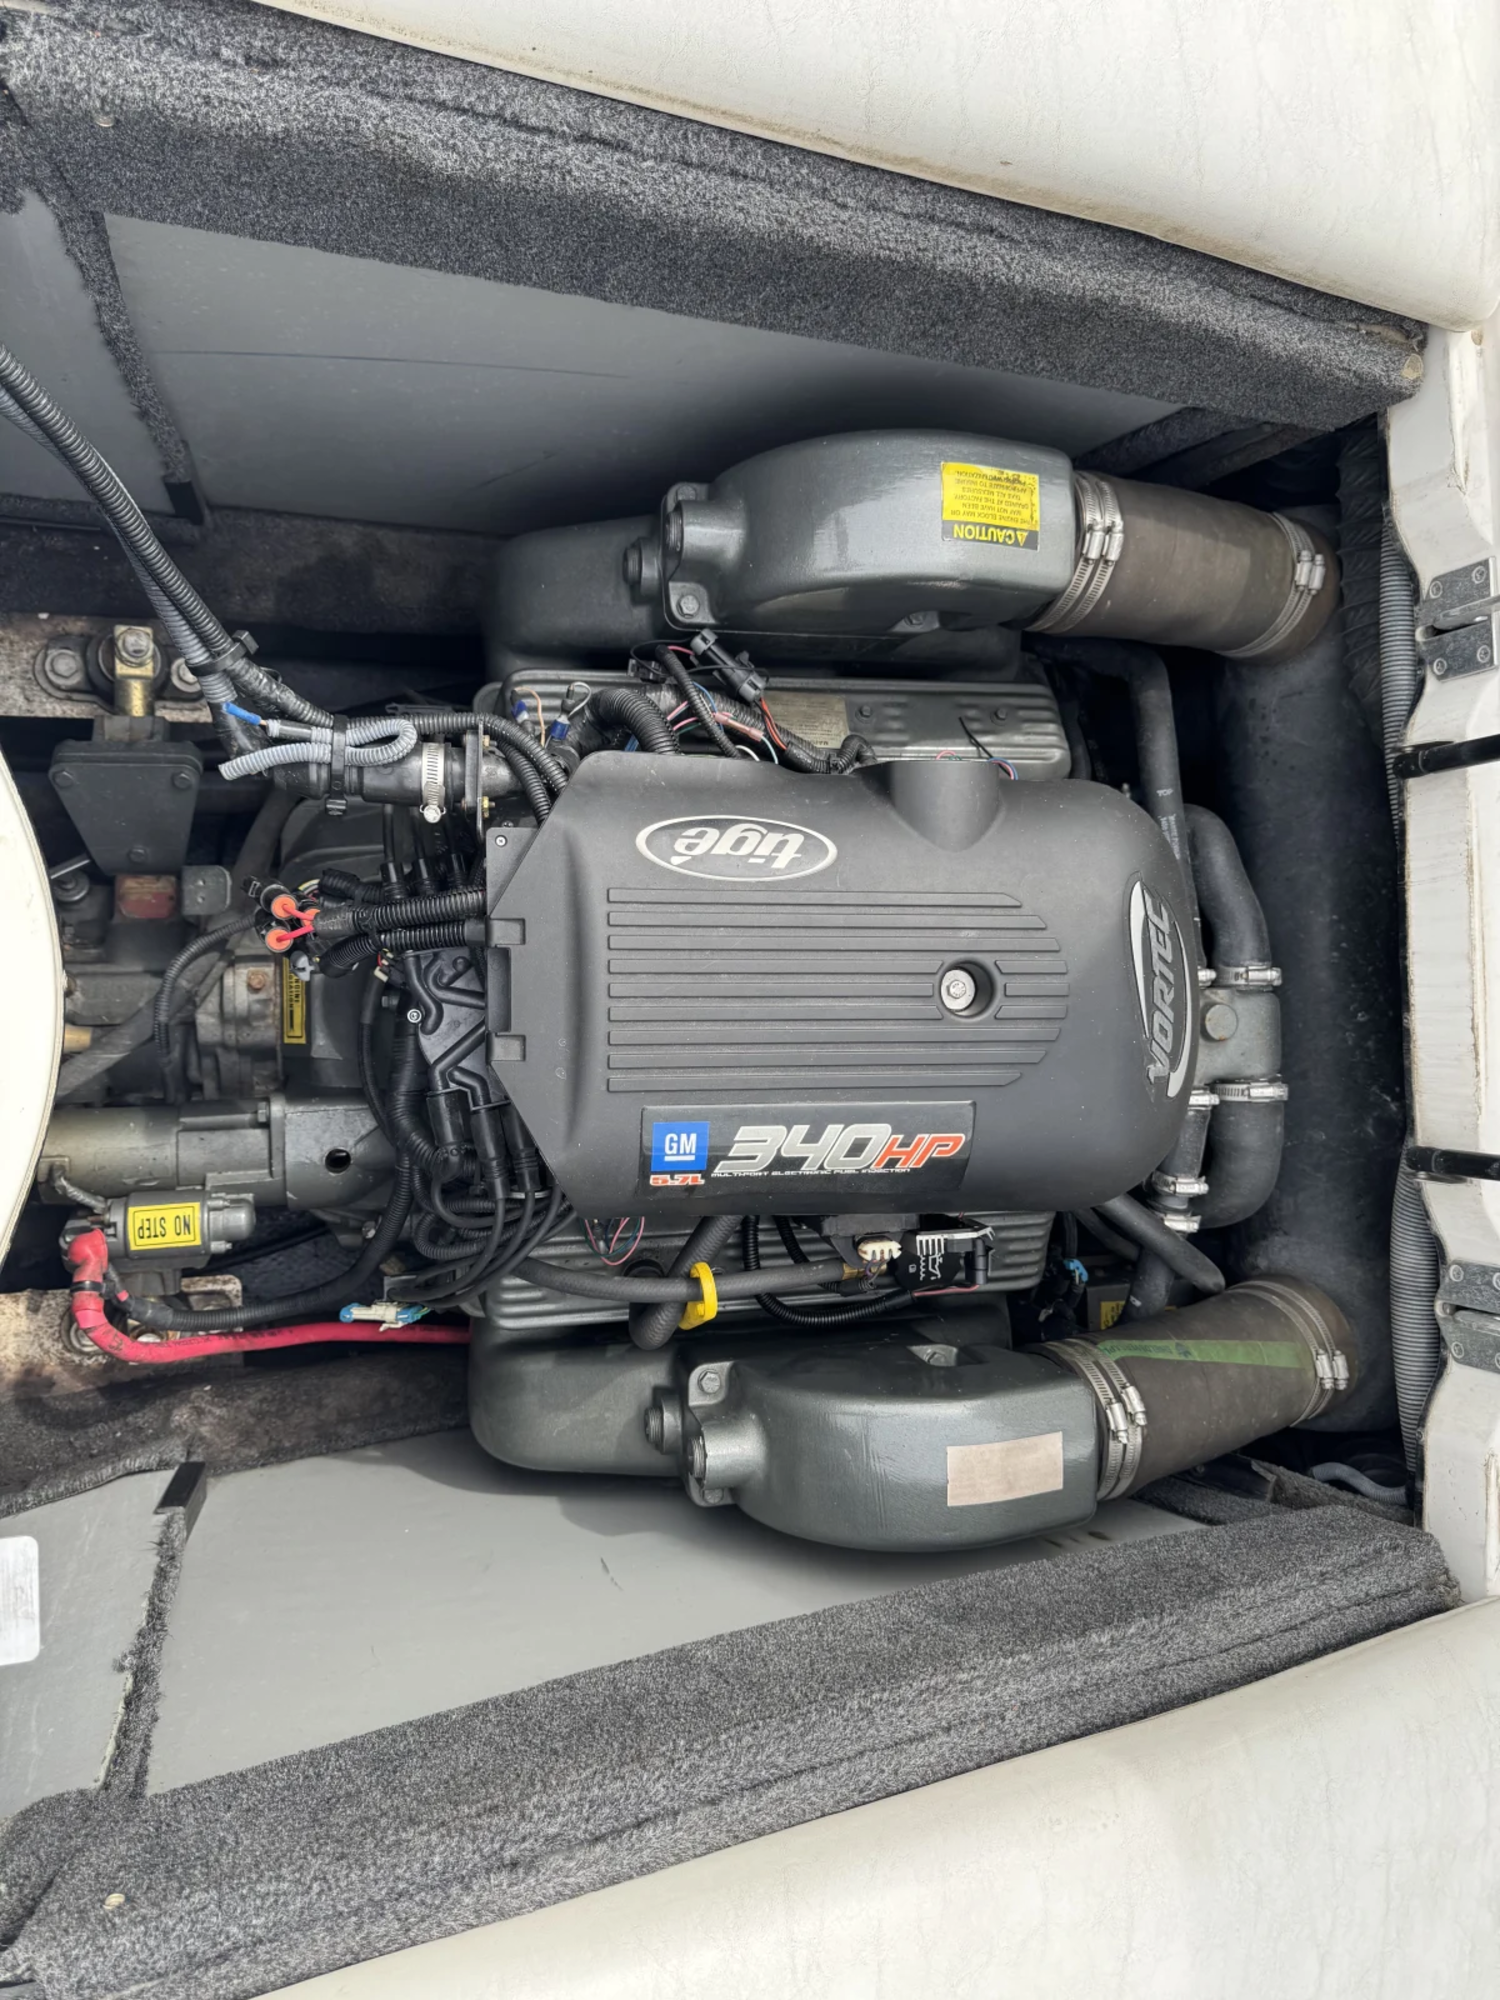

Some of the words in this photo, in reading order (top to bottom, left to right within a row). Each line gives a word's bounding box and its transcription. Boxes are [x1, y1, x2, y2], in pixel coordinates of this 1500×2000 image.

[962, 487, 994, 496] MEASURES
[1005, 501, 1029, 510] DRAINED
[978, 512, 996, 520] BLOCK
[999, 515, 1018, 523] ENGINE
[954, 524, 1015, 544] CAUTION
[1145, 887, 1176, 1085] VORTEC
[664, 1132, 698, 1157] GM
[861, 1167, 911, 1175] INJECTION
[649, 1173, 706, 1186] 5.7L
[137, 1216, 166, 1239] STEP
[174, 1214, 191, 1236] NO
